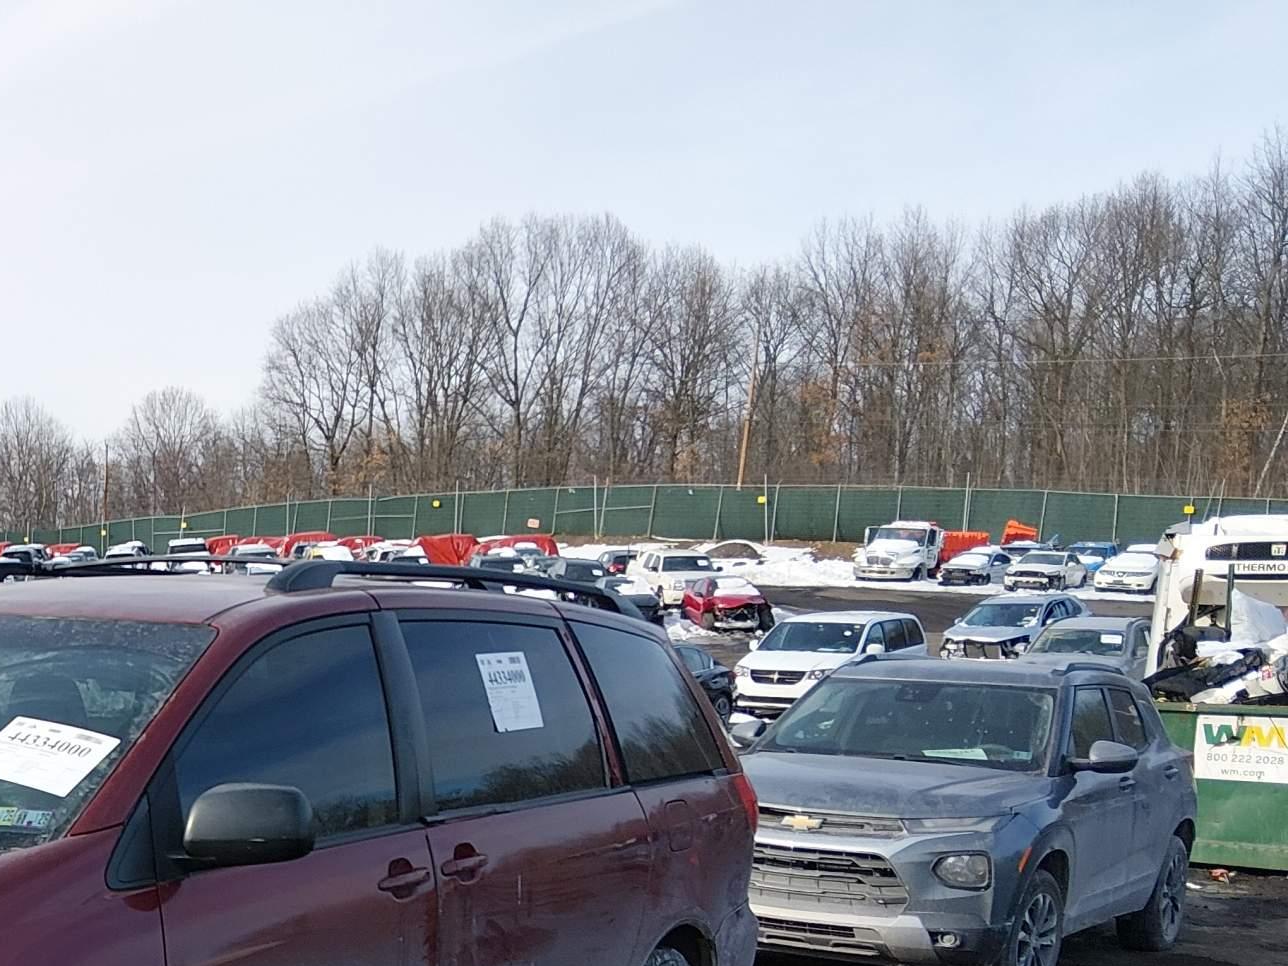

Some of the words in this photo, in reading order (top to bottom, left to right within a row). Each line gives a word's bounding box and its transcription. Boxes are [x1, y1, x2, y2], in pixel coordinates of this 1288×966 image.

[1236, 563, 1286, 572] THERMO
[1203, 723, 1285, 749] WM
[7, 731, 93, 758] 44334000
[1206, 752, 1228, 762] 800
[1231, 753, 1253, 764] 222
[1255, 755, 1285, 765] 2028
[1220, 768, 1265, 777] wm.com
